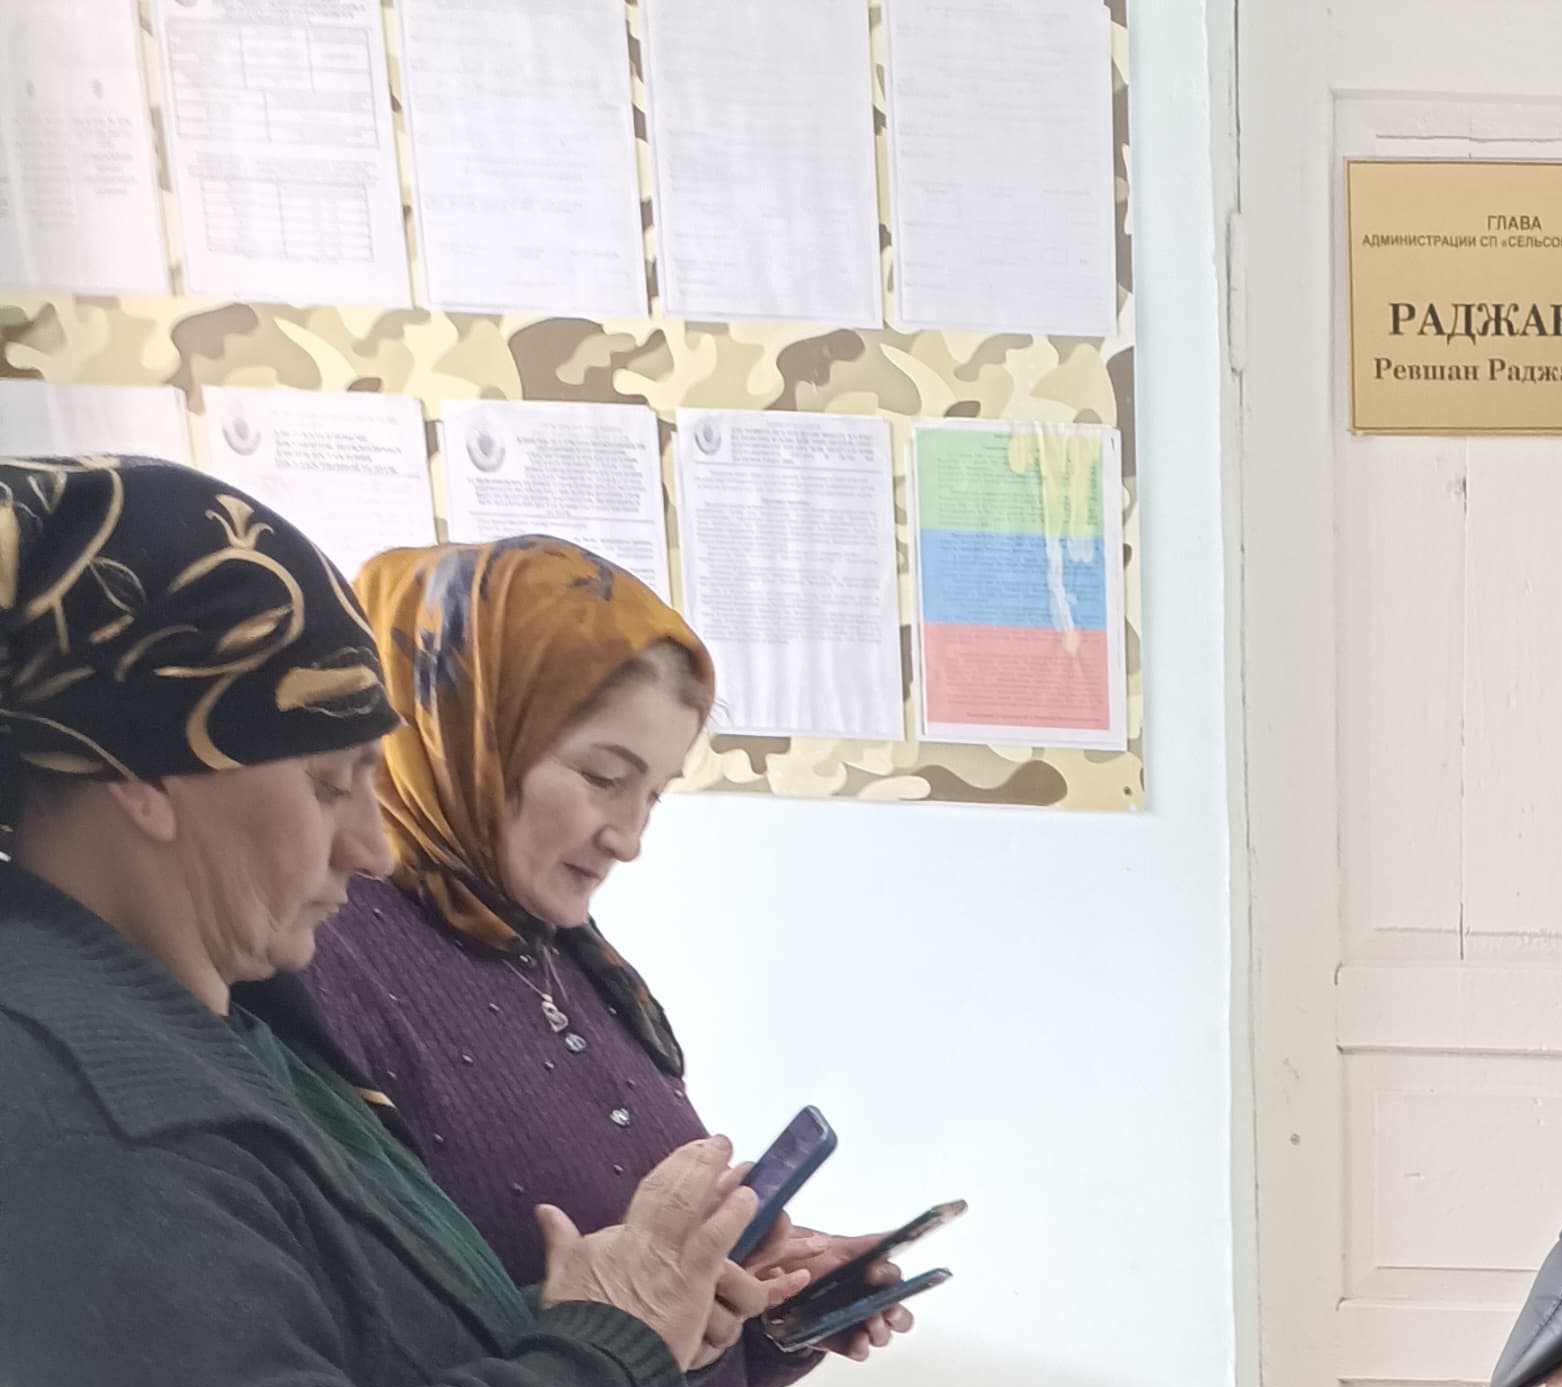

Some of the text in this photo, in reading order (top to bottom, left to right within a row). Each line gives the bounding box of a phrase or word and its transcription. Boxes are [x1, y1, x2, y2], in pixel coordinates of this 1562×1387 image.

[1487, 215, 1542, 231] ГЛАВА
[1362, 234, 1477, 249] АДМИНИСТРАЦИИ
[1480, 235, 1498, 248] СП
[1374, 357, 1479, 381] Ревшан
